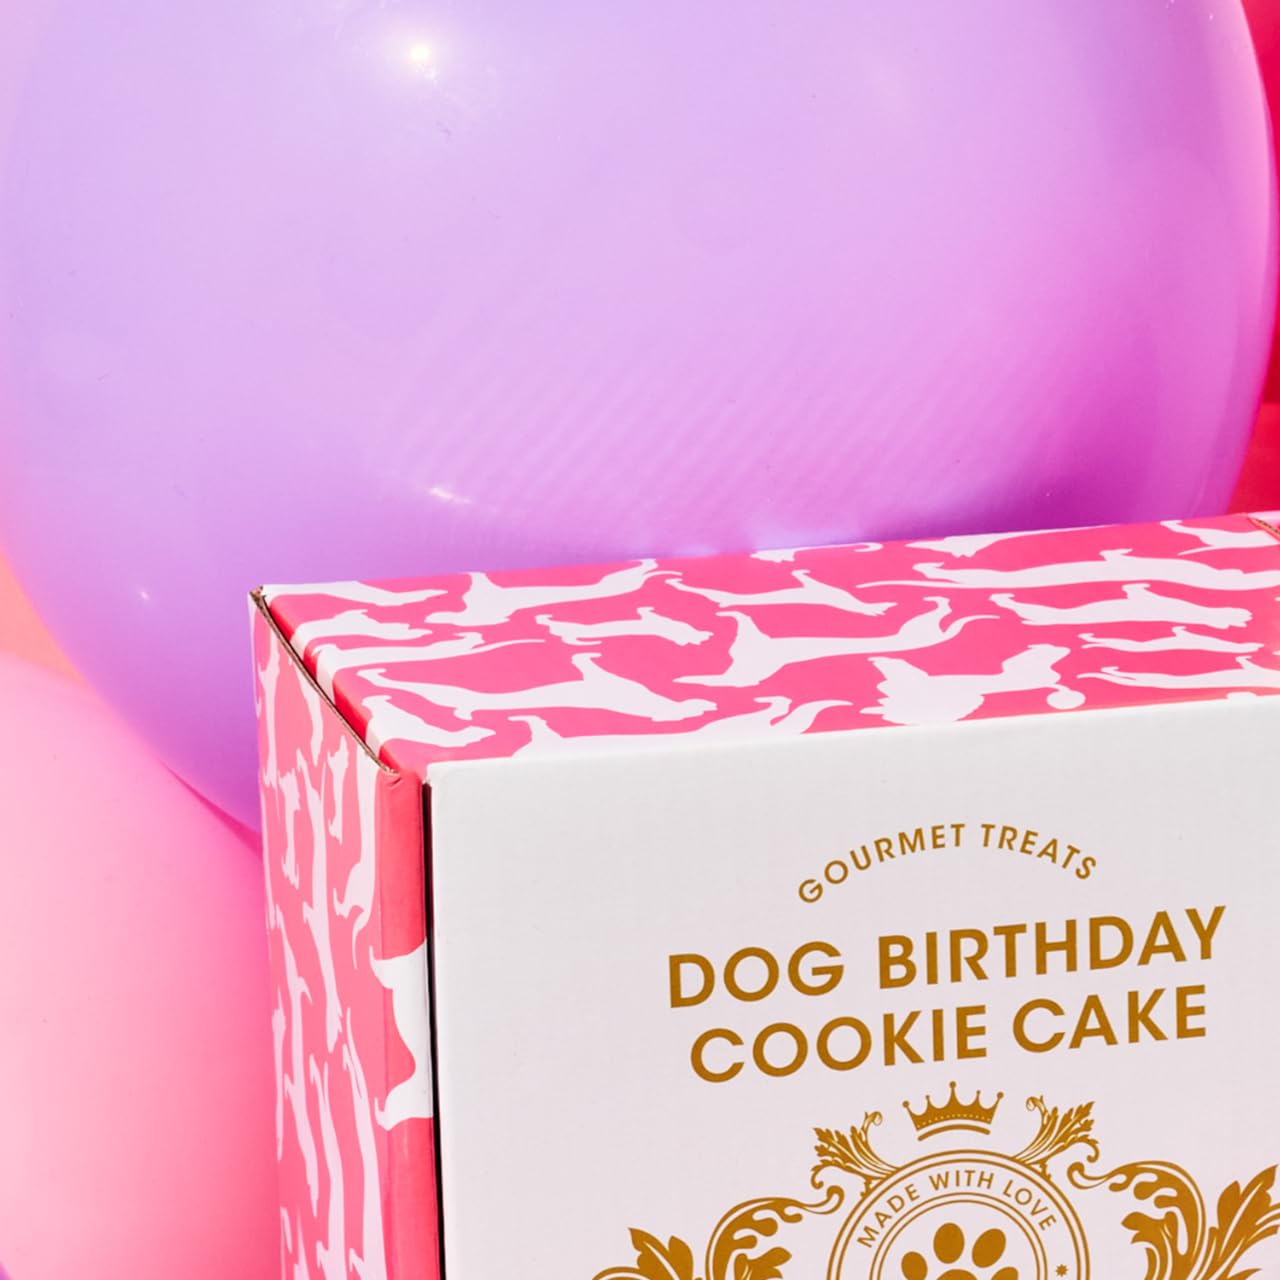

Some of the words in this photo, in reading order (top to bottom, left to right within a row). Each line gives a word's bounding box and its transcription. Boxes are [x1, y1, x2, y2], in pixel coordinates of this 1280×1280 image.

[799, 823, 966, 904] GOURMET
[981, 823, 1097, 881] TREATS
[668, 939, 845, 1009] DOG
[878, 904, 1227, 990] BIRTHDAY
[690, 1003, 989, 1084] COOKIE
[1012, 984, 1207, 1054] CAKE
[855, 1183, 921, 1249] MADE
[928, 1168, 995, 1191] WITH
[1002, 1179, 1057, 1232] LOVE
